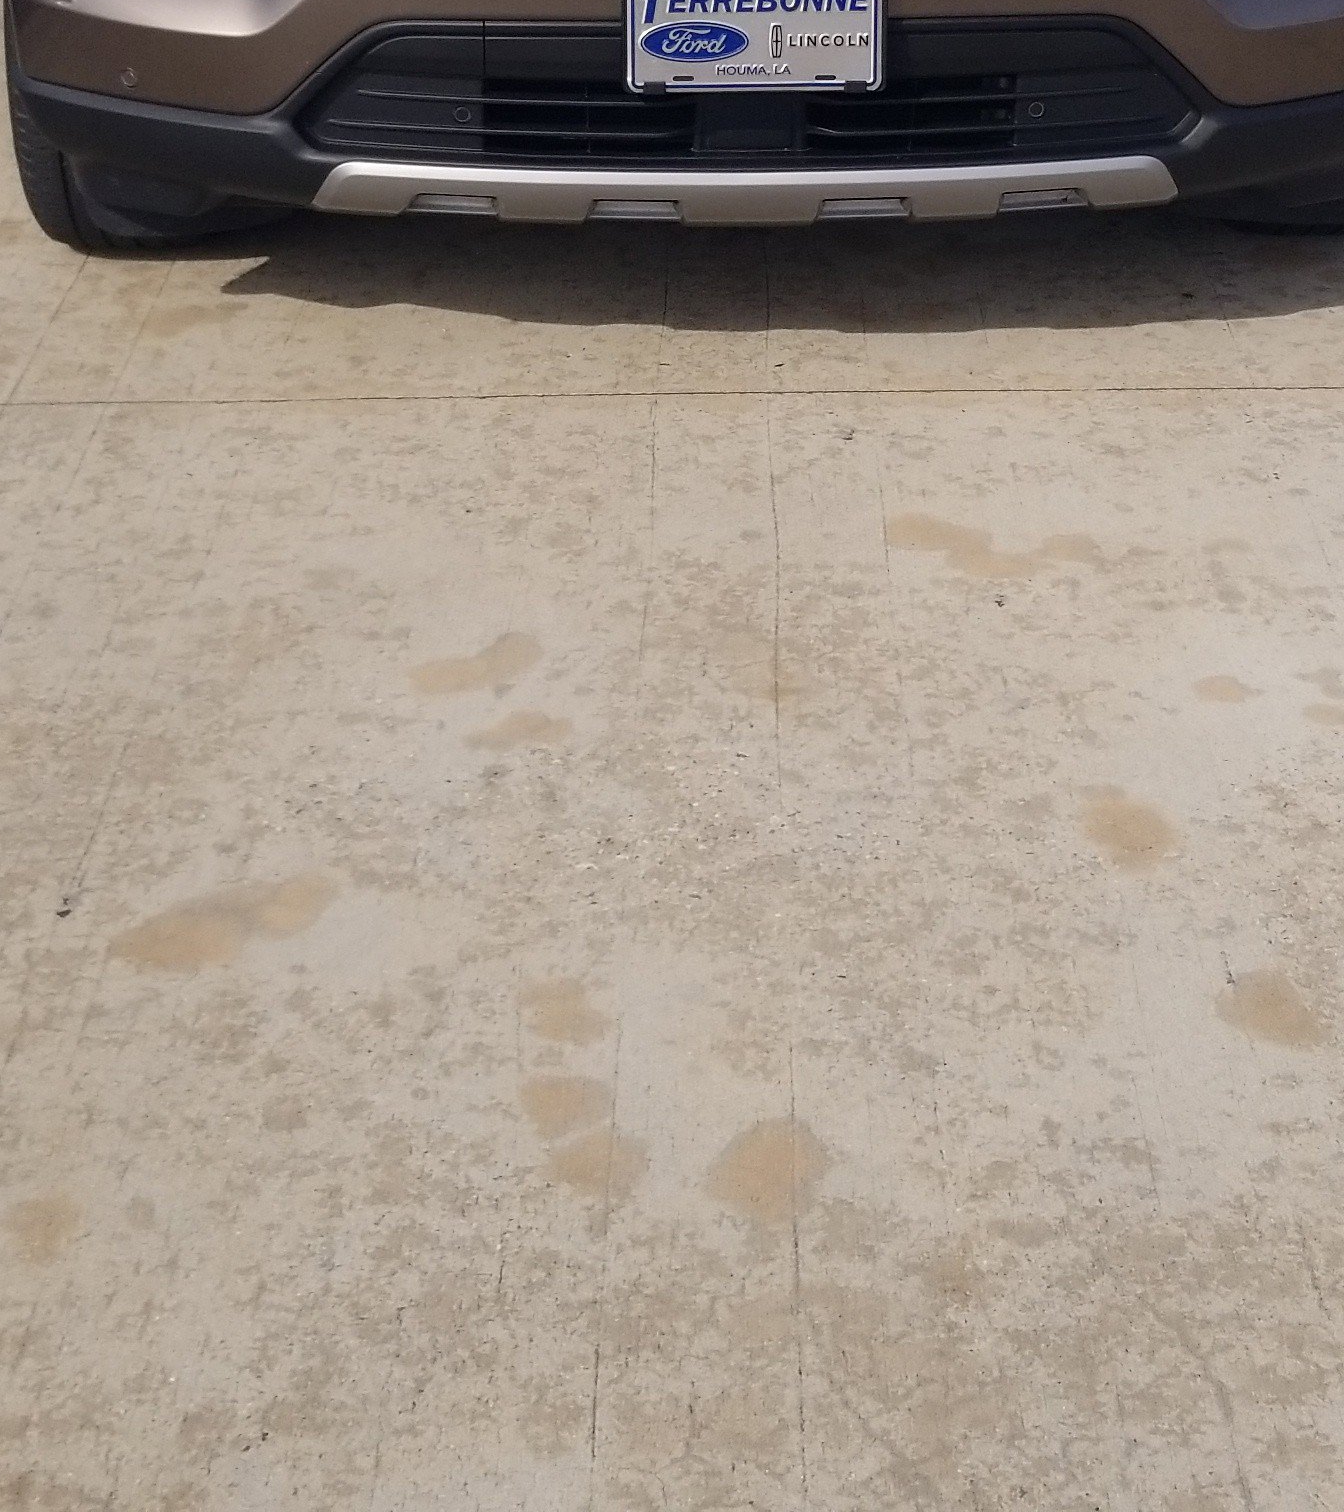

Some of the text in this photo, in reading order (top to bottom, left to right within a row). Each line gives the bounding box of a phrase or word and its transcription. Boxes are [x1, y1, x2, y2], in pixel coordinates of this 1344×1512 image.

[661, 27, 870, 55] Ford LINCOLN
[716, 63, 791, 76] HOUMA, LA
